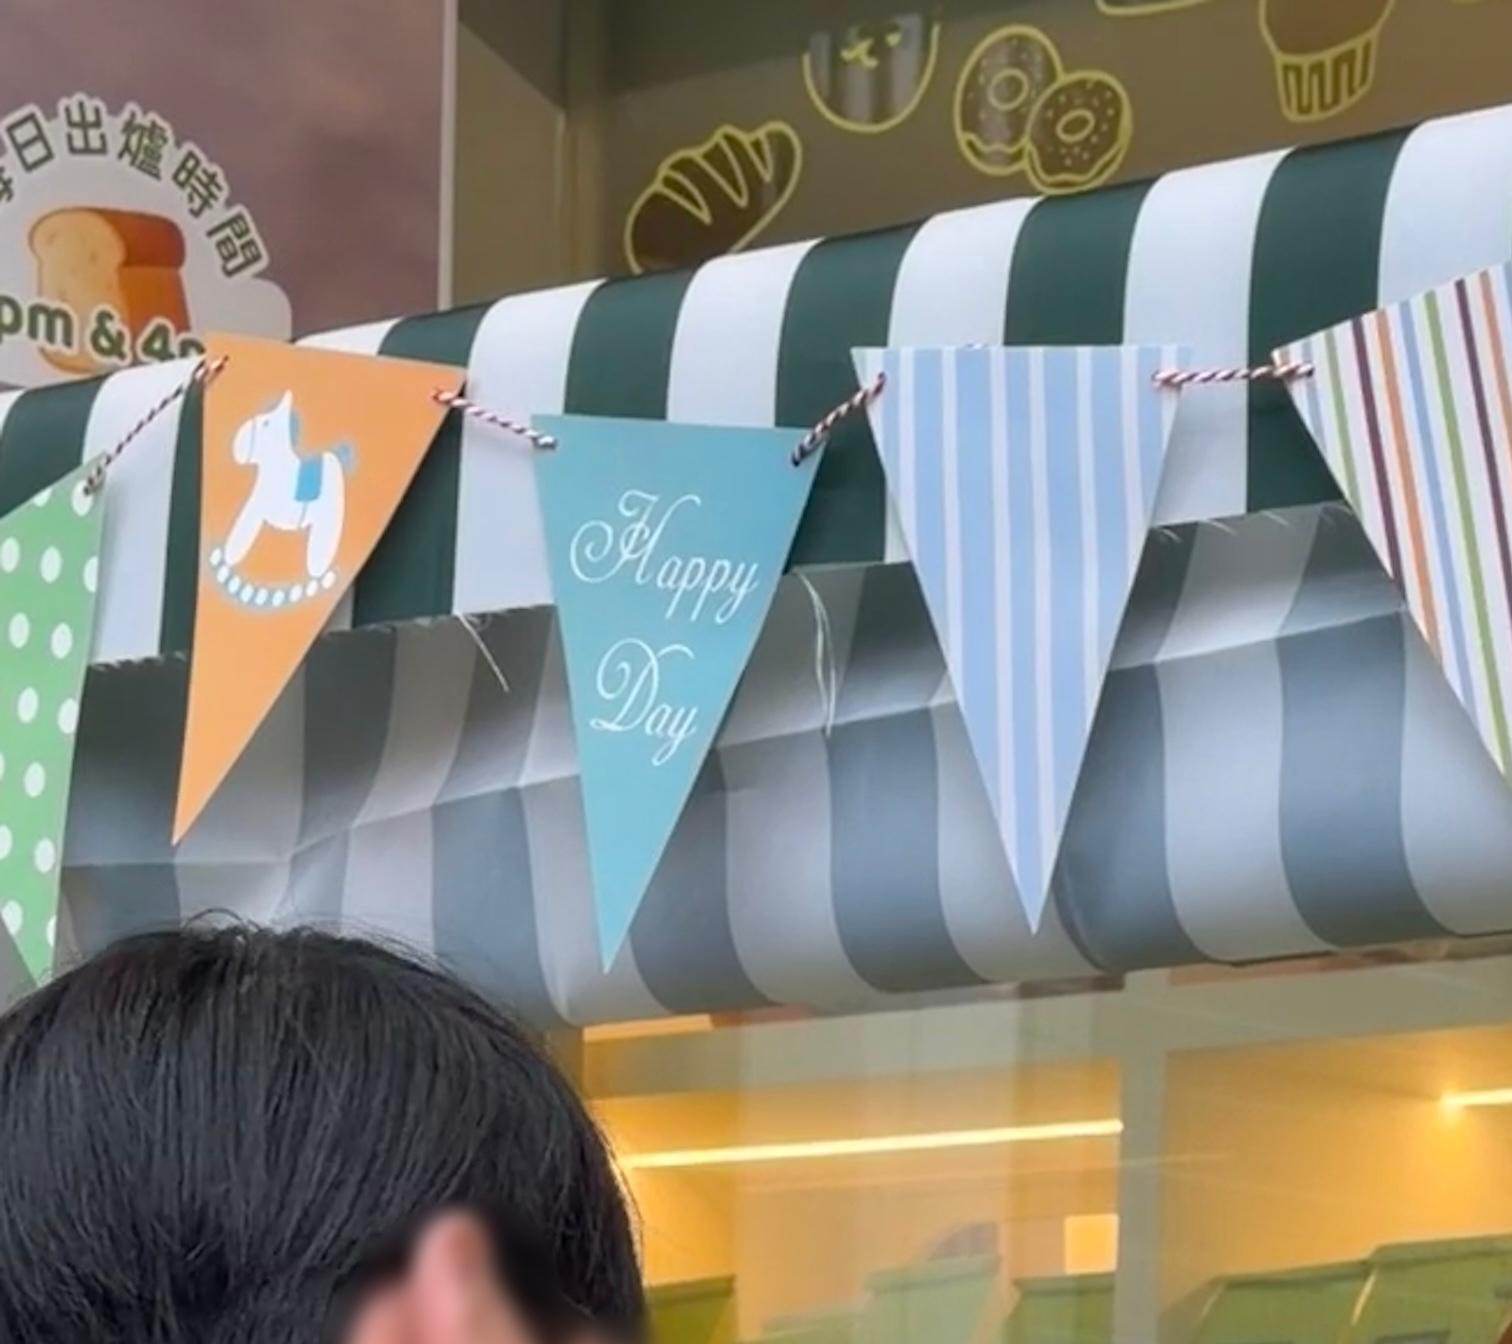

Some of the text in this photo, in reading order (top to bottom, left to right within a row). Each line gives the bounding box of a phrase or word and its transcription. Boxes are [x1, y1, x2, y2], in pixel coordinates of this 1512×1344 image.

[91, 308, 127, 360] &
[570, 489, 758, 624] Happy
[589, 638, 697, 766] Day
